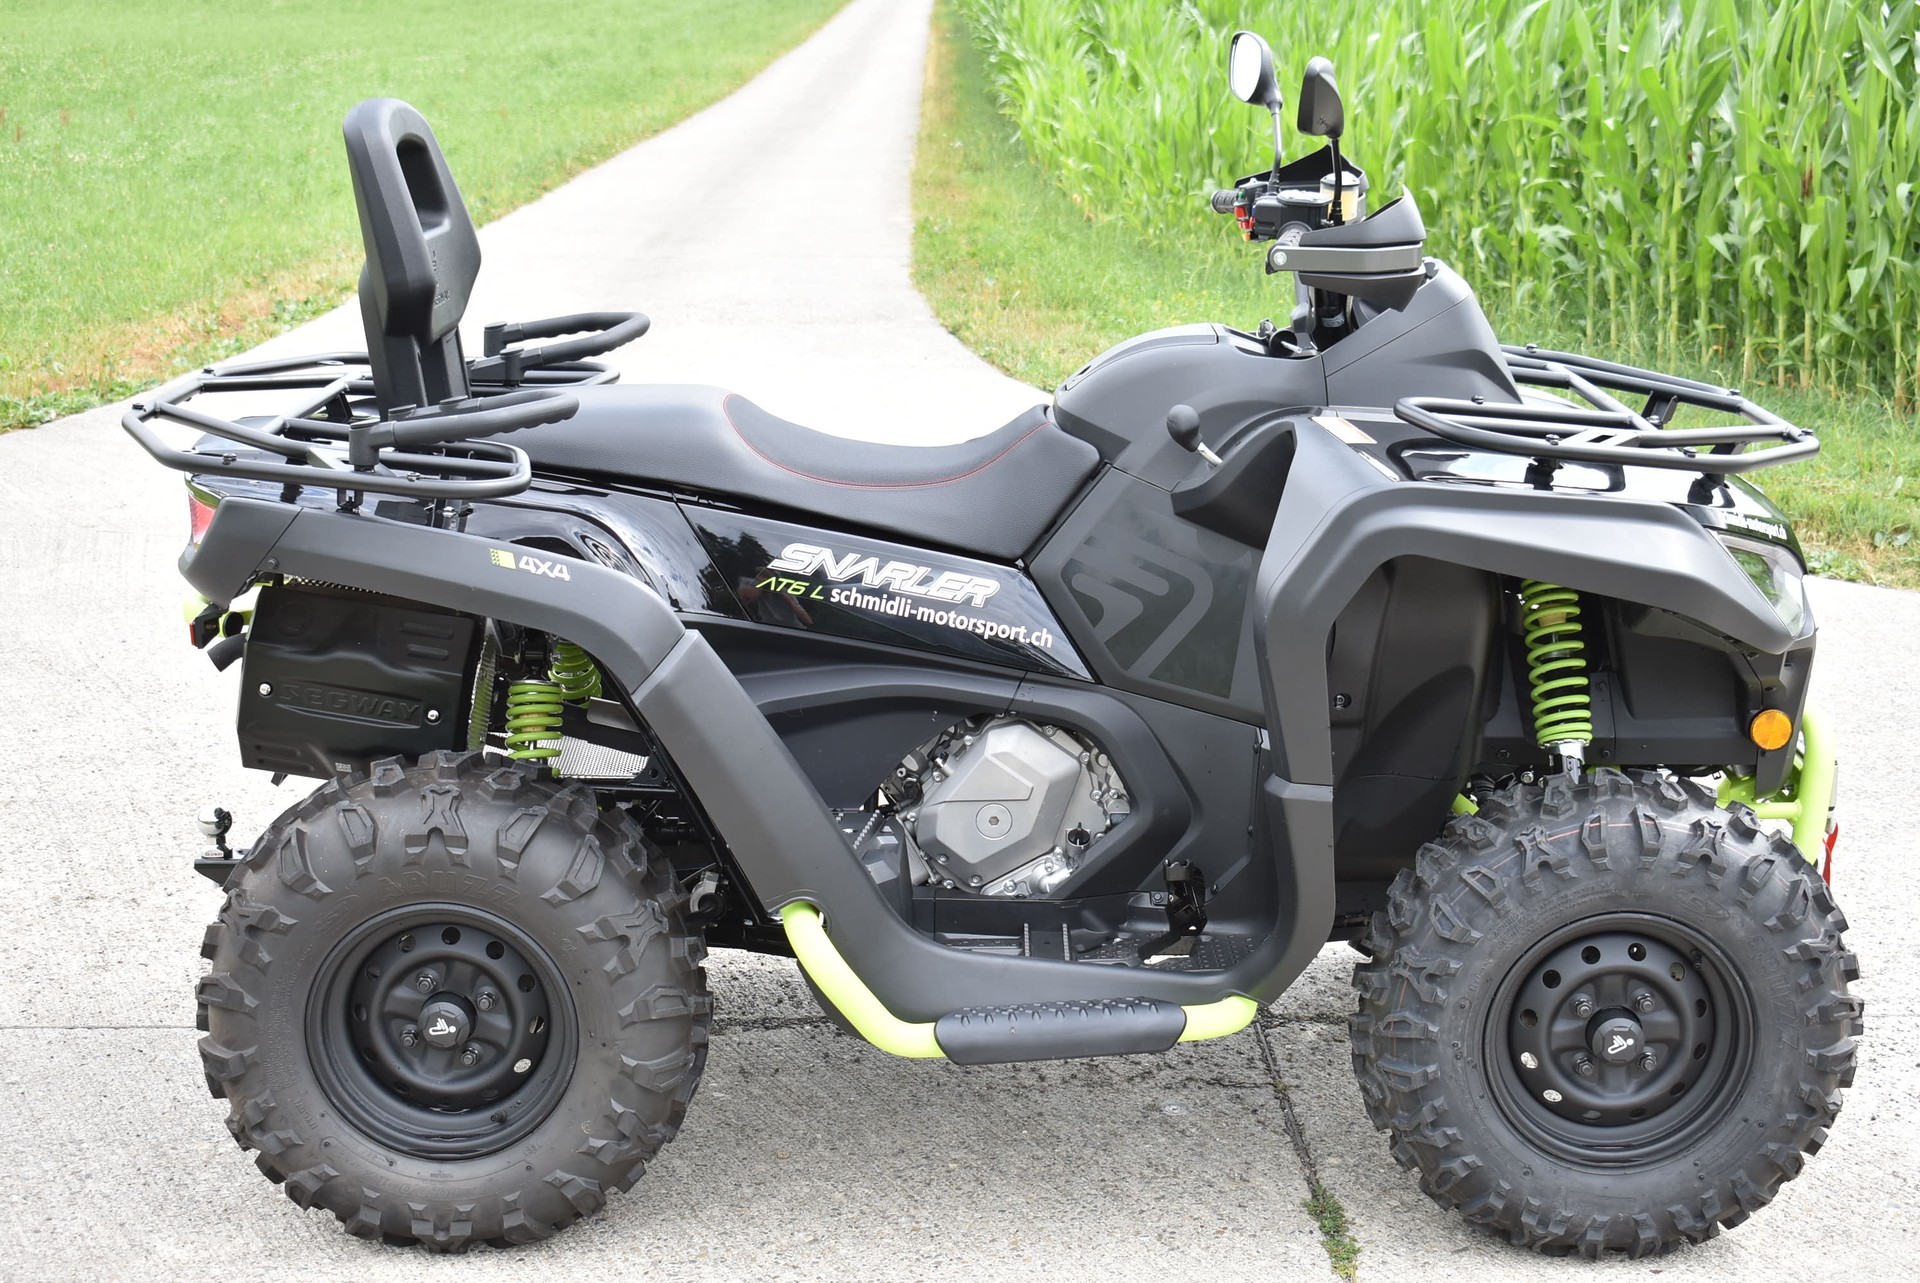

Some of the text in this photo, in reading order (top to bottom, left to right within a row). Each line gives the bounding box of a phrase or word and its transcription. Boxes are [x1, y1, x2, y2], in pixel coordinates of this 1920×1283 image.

[755, 576, 824, 600] AT6 L
[767, 543, 1000, 608] SNARLER
[830, 587, 1053, 648] schmidli-motorsport.ch
[279, 684, 420, 721] SEGWAY
